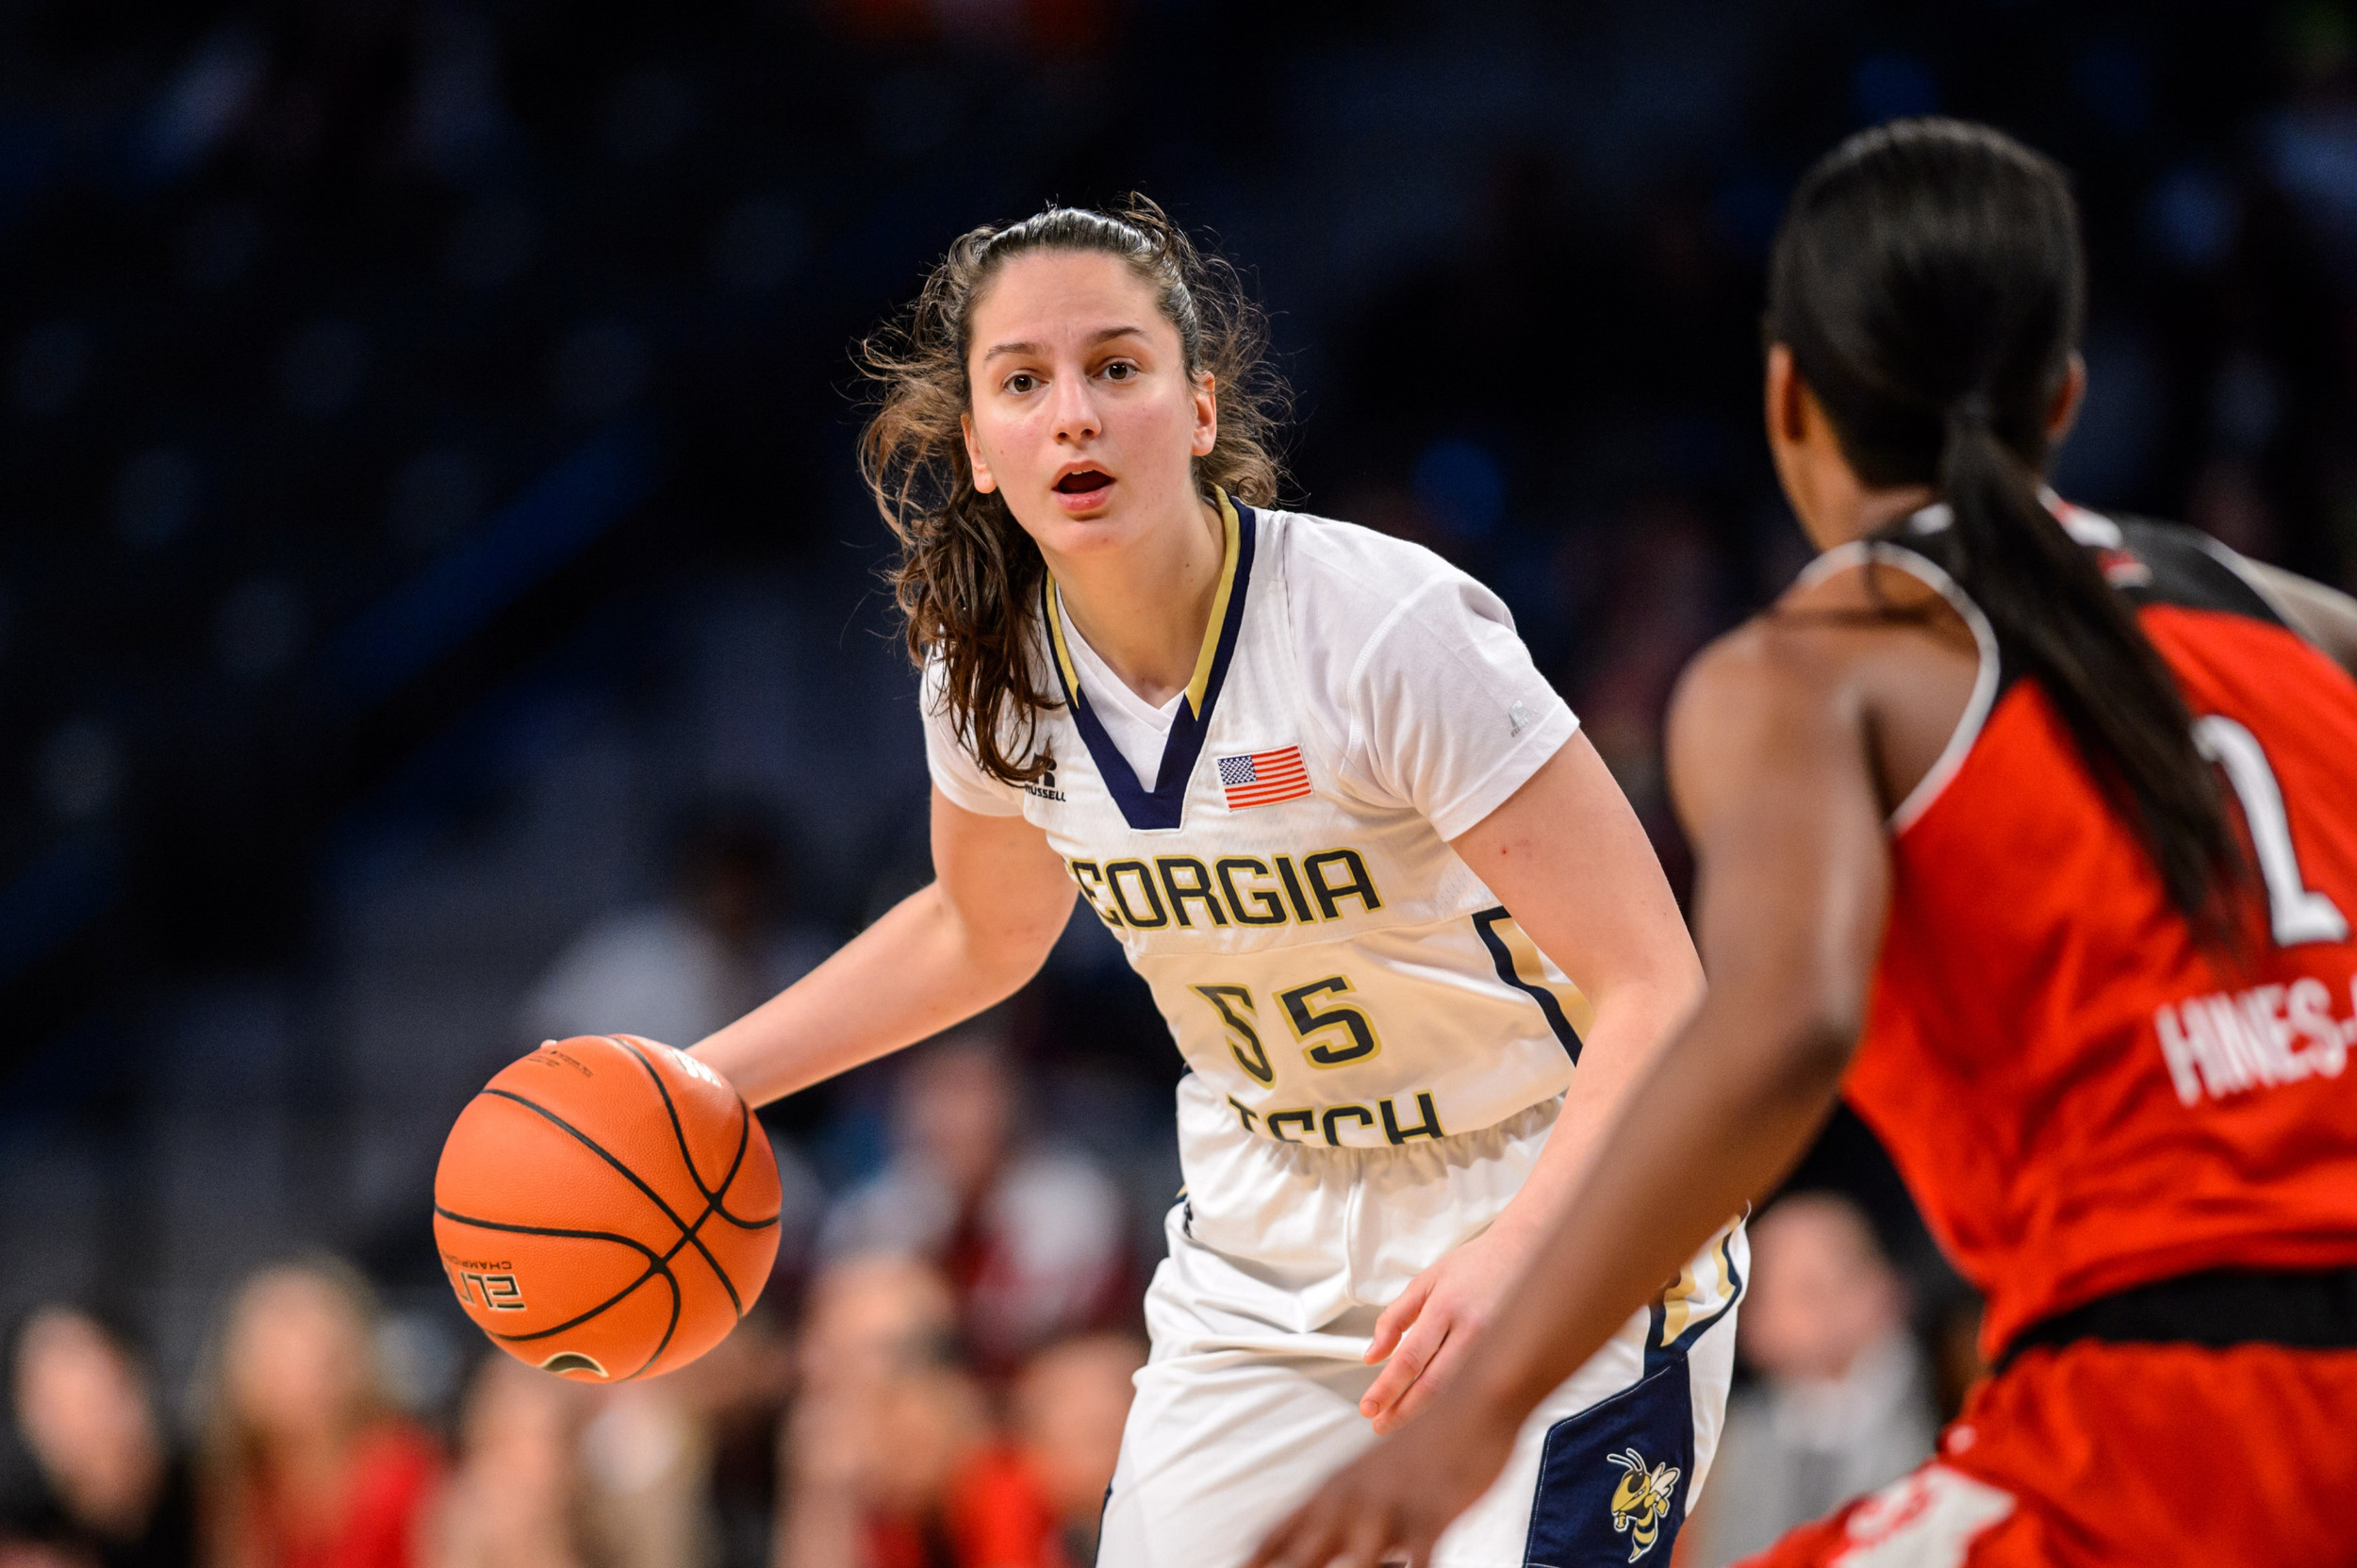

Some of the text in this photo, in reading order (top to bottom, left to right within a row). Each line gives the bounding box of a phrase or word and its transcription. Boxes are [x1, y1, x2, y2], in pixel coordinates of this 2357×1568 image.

[1067, 847, 1384, 932] EORGIA
[1188, 973, 1383, 1090] 55
[2155, 974, 2357, 1106] HINES-
